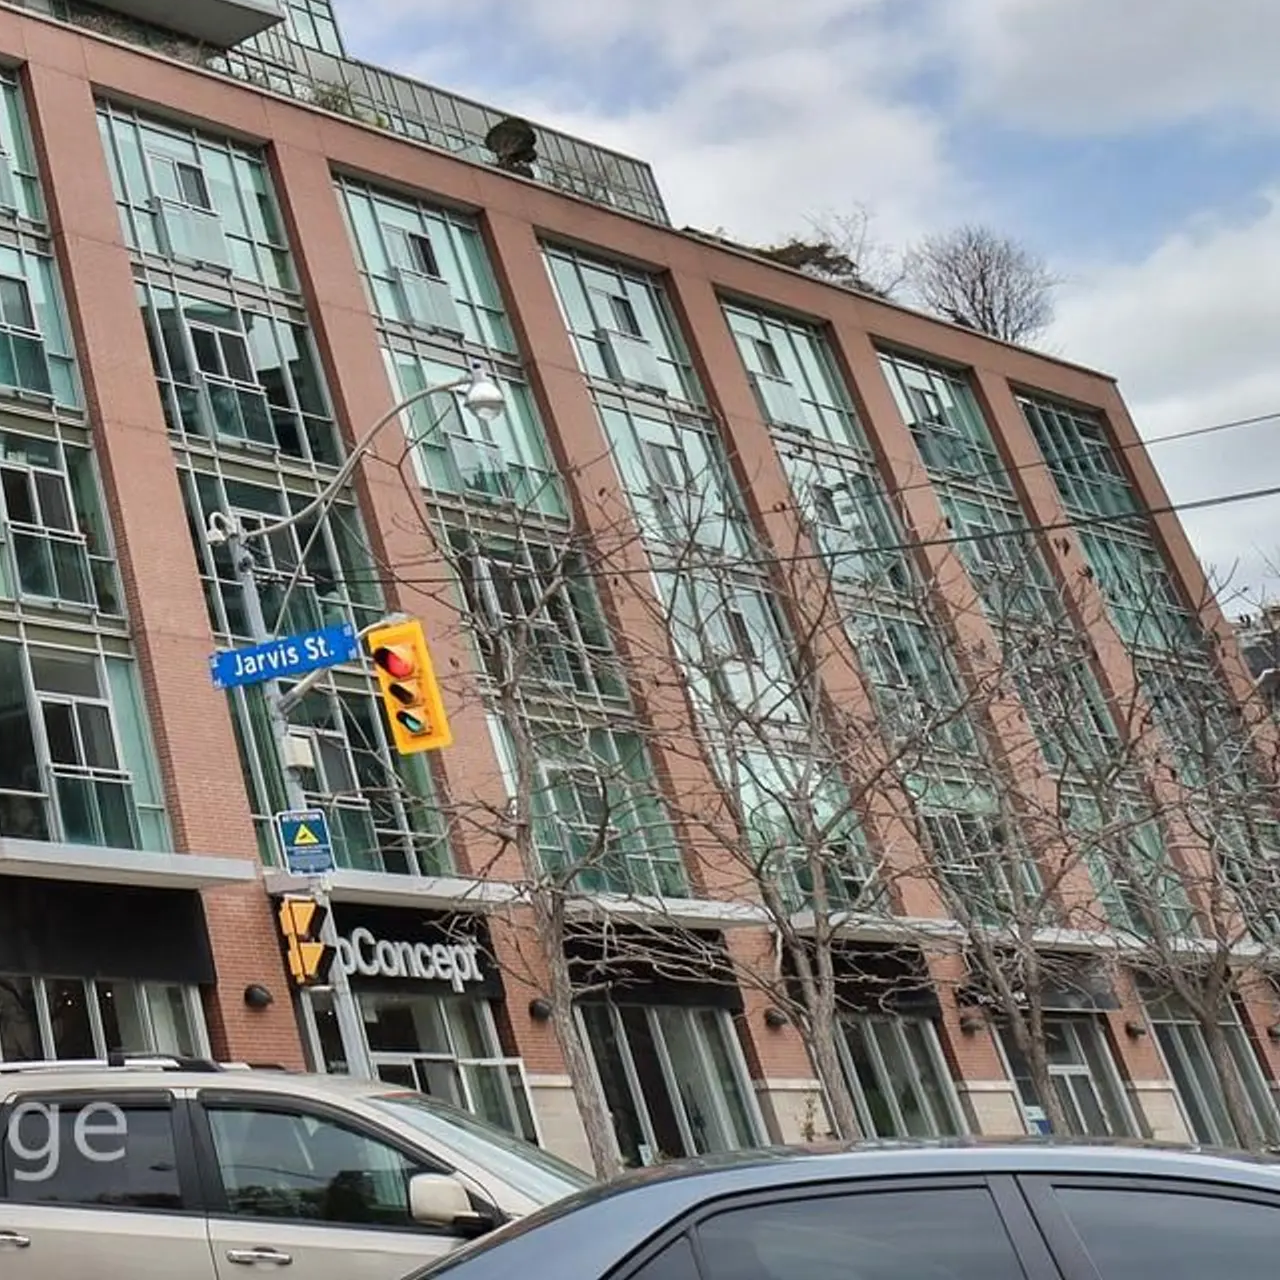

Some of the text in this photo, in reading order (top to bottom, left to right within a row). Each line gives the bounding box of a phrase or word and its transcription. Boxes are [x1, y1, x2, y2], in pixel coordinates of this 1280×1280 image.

[234, 644, 300, 677] Jarvis
[304, 636, 335, 661] St.
[335, 927, 484, 993] oConcept
